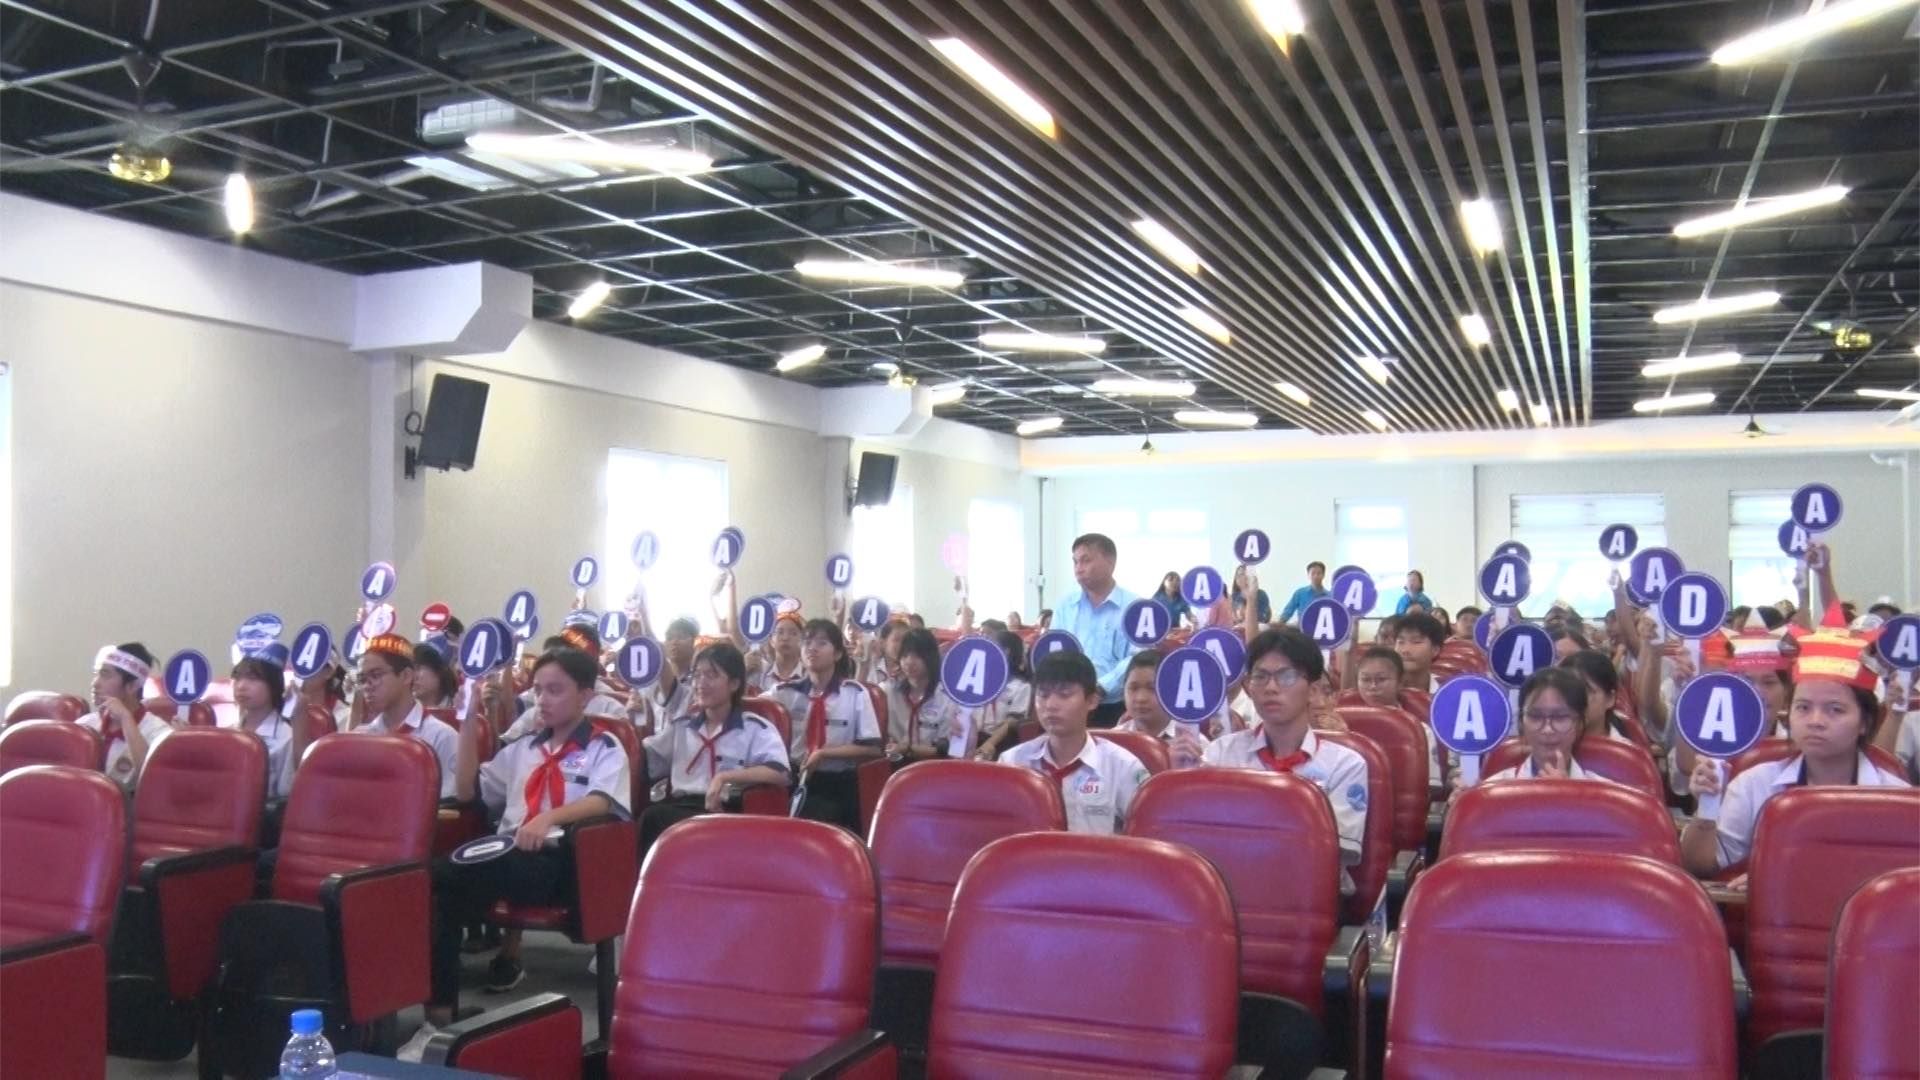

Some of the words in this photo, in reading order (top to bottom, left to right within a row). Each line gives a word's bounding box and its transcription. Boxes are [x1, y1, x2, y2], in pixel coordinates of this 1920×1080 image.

[1804, 493, 1829, 524] A
[639, 534, 653, 565] A
[714, 538, 730, 564] A
[1243, 535, 1260, 558] A
[1608, 531, 1625, 556] A
[1790, 526, 1808, 551] A
[367, 569, 386, 596] A
[577, 560, 593, 584] D
[833, 559, 849, 583] D
[1192, 573, 1211, 600] A
[1493, 563, 1517, 598] A
[1644, 557, 1668, 593] A
[510, 595, 527, 622] A
[1343, 579, 1363, 611] A
[1679, 584, 1707, 627] D
[605, 613, 621, 638] A
[749, 605, 765, 634] D
[860, 599, 878, 626] A
[1135, 607, 1156, 638] A
[1313, 606, 1336, 640] A
[296, 632, 320, 670] A
[466, 631, 488, 667] A
[1505, 635, 1534, 676] A
[1892, 624, 1918, 661] A
[175, 659, 196, 694] A
[630, 644, 649, 678] D
[956, 648, 987, 695] A
[1175, 659, 1205, 708] A
[1453, 689, 1487, 740] A
[1698, 687, 1737, 743] A
